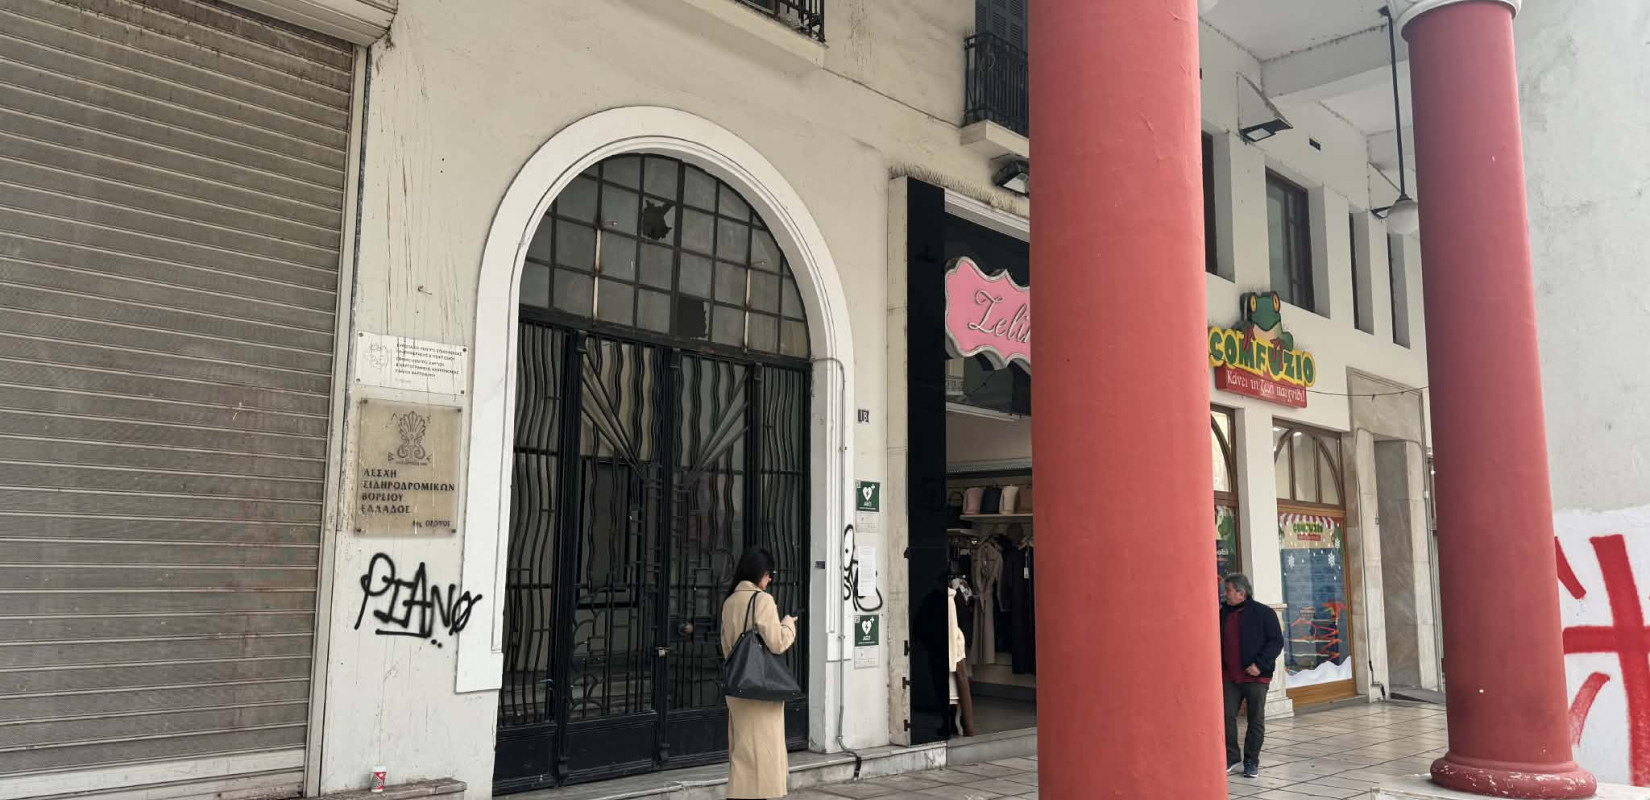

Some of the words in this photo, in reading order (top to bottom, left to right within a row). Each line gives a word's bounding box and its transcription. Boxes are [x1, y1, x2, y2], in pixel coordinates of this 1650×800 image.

[1208, 328, 1315, 386] COMFUZIO
[1227, 371, 1248, 388] Κάνει
[363, 468, 397, 478] ΛΕΣΧΗ
[362, 481, 455, 491] ΣΙΔΗΡΟΔΡΟΜΙΚΩΝ
[362, 492, 403, 502] ΒΟΡΕΙΟΥ
[361, 504, 411, 514] ΕΛΛΑΔΟΣ
